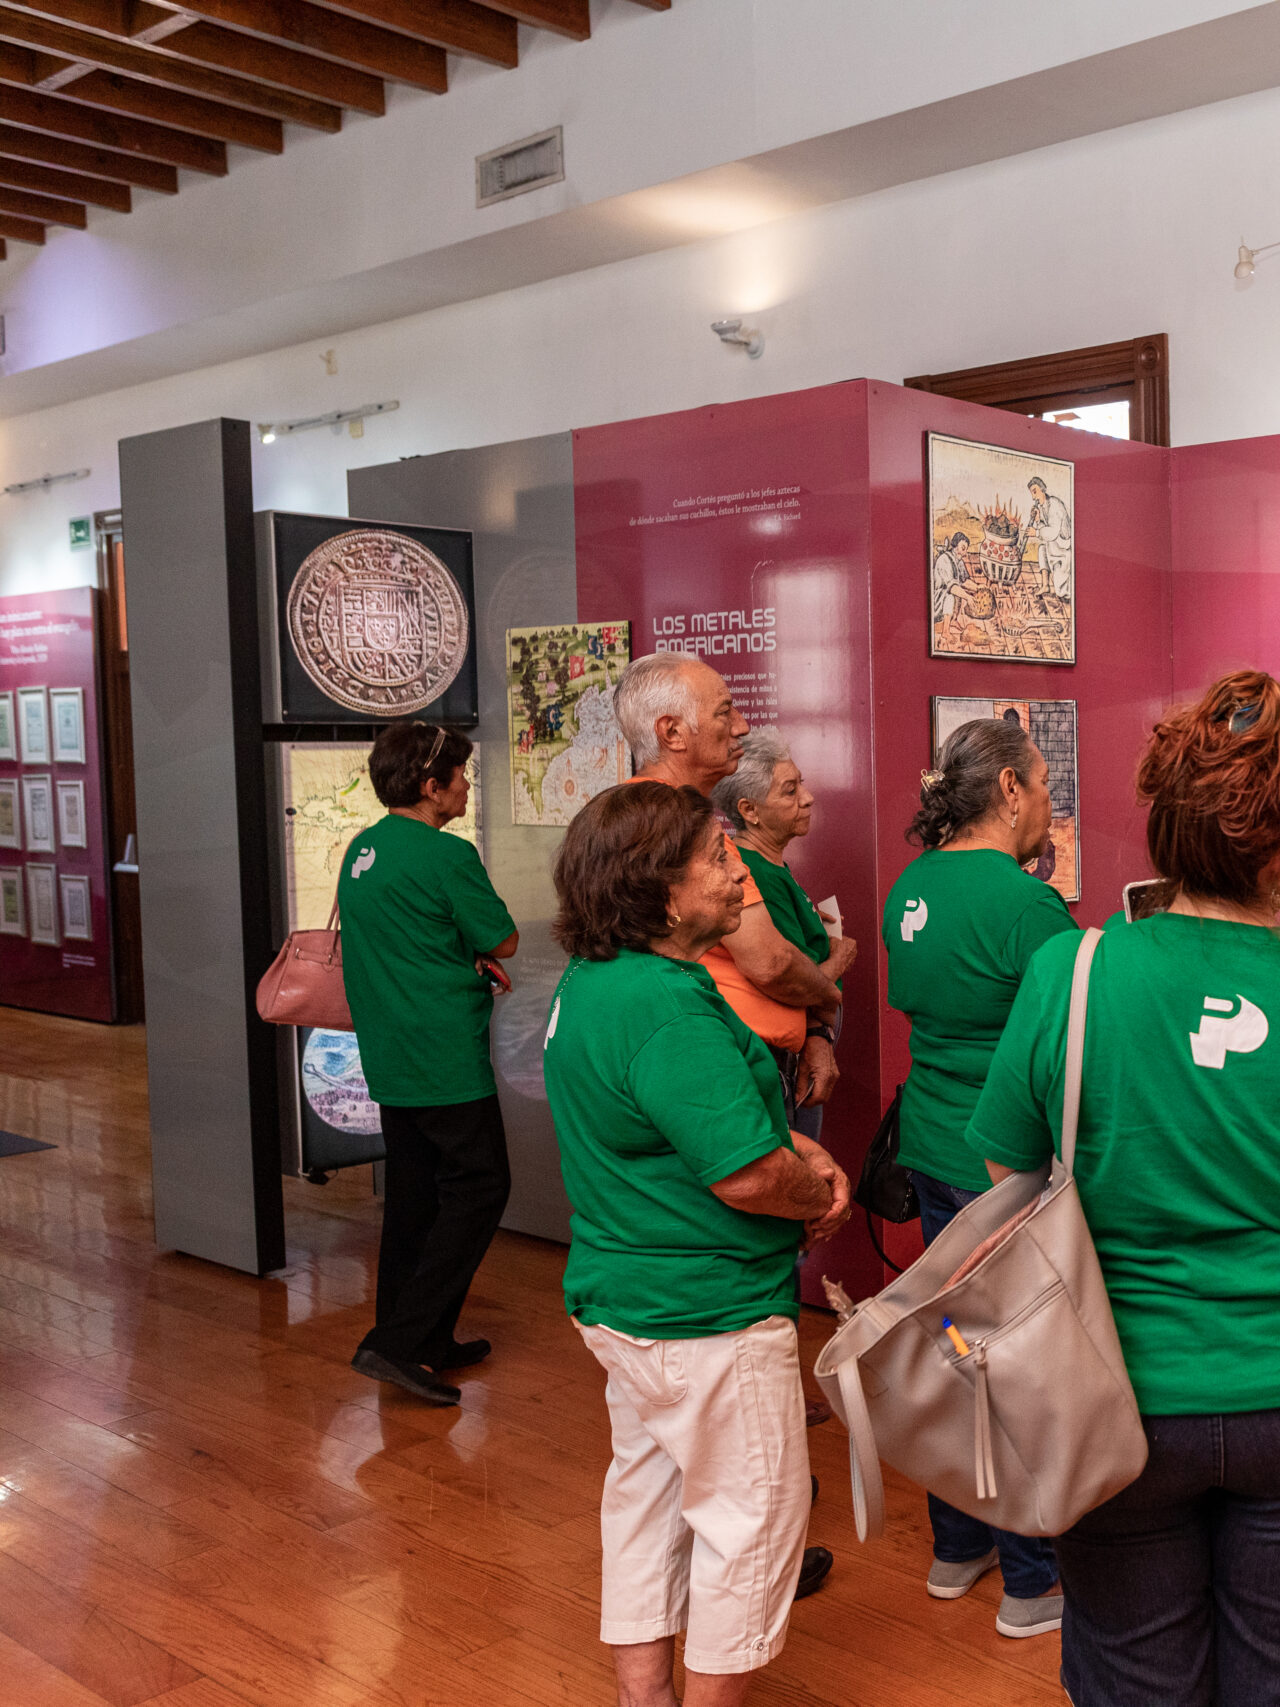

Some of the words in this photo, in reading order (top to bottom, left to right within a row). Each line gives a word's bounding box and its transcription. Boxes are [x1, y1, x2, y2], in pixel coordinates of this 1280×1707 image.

[673, 497, 695, 507] Cuando
[717, 491, 745, 504] preguntó
[751, 489, 760, 498] los
[761, 487, 776, 499] jefes
[777, 486, 800, 495] aztecas
[629, 517, 636, 526] de
[735, 504, 740, 513] le
[742, 501, 775, 512] mostraban
[777, 499, 782, 508] el
[653, 615, 686, 635] LOS
[691, 607, 776, 632] METALES
[655, 631, 777, 655] AMERICANOS
[729, 685, 749, 695] xistencia
